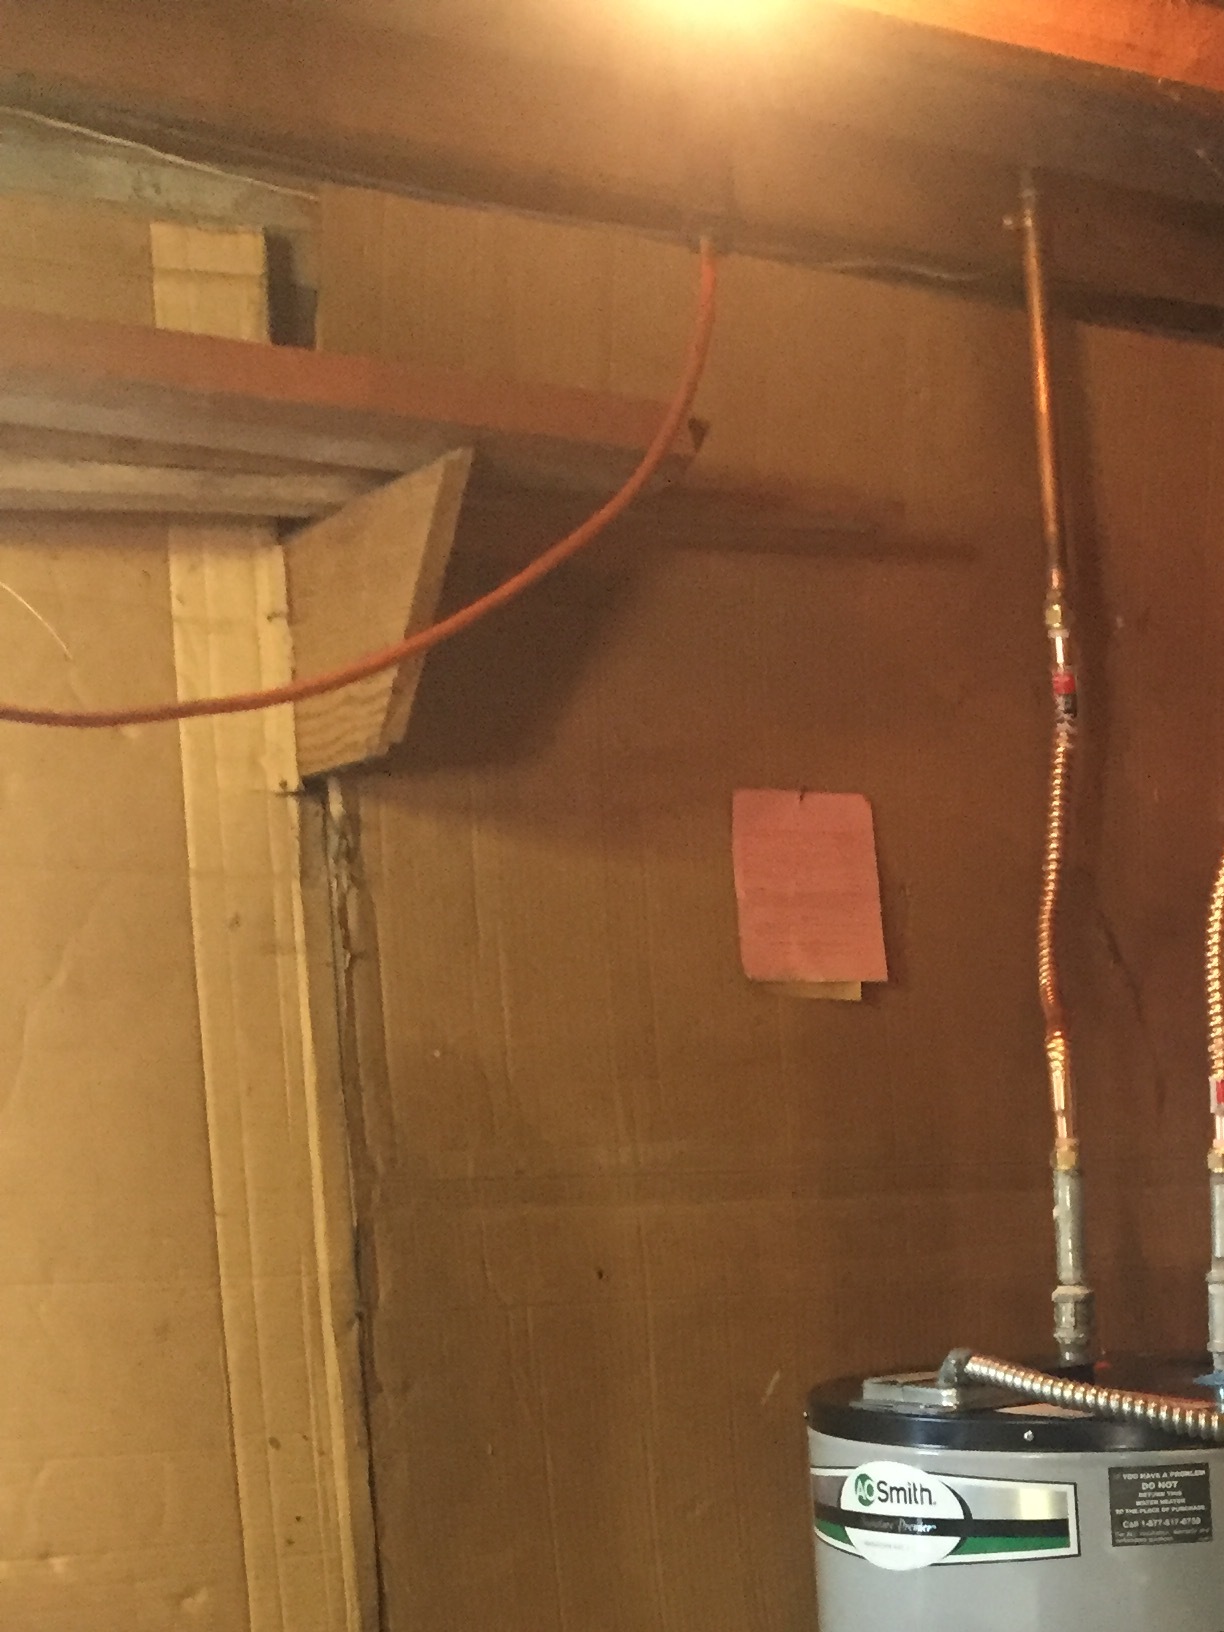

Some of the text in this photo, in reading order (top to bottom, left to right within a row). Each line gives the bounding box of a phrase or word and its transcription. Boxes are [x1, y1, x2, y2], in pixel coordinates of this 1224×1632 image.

[877, 1480, 933, 1505] Smith
[1141, 1480, 1179, 1490] DO NOT
